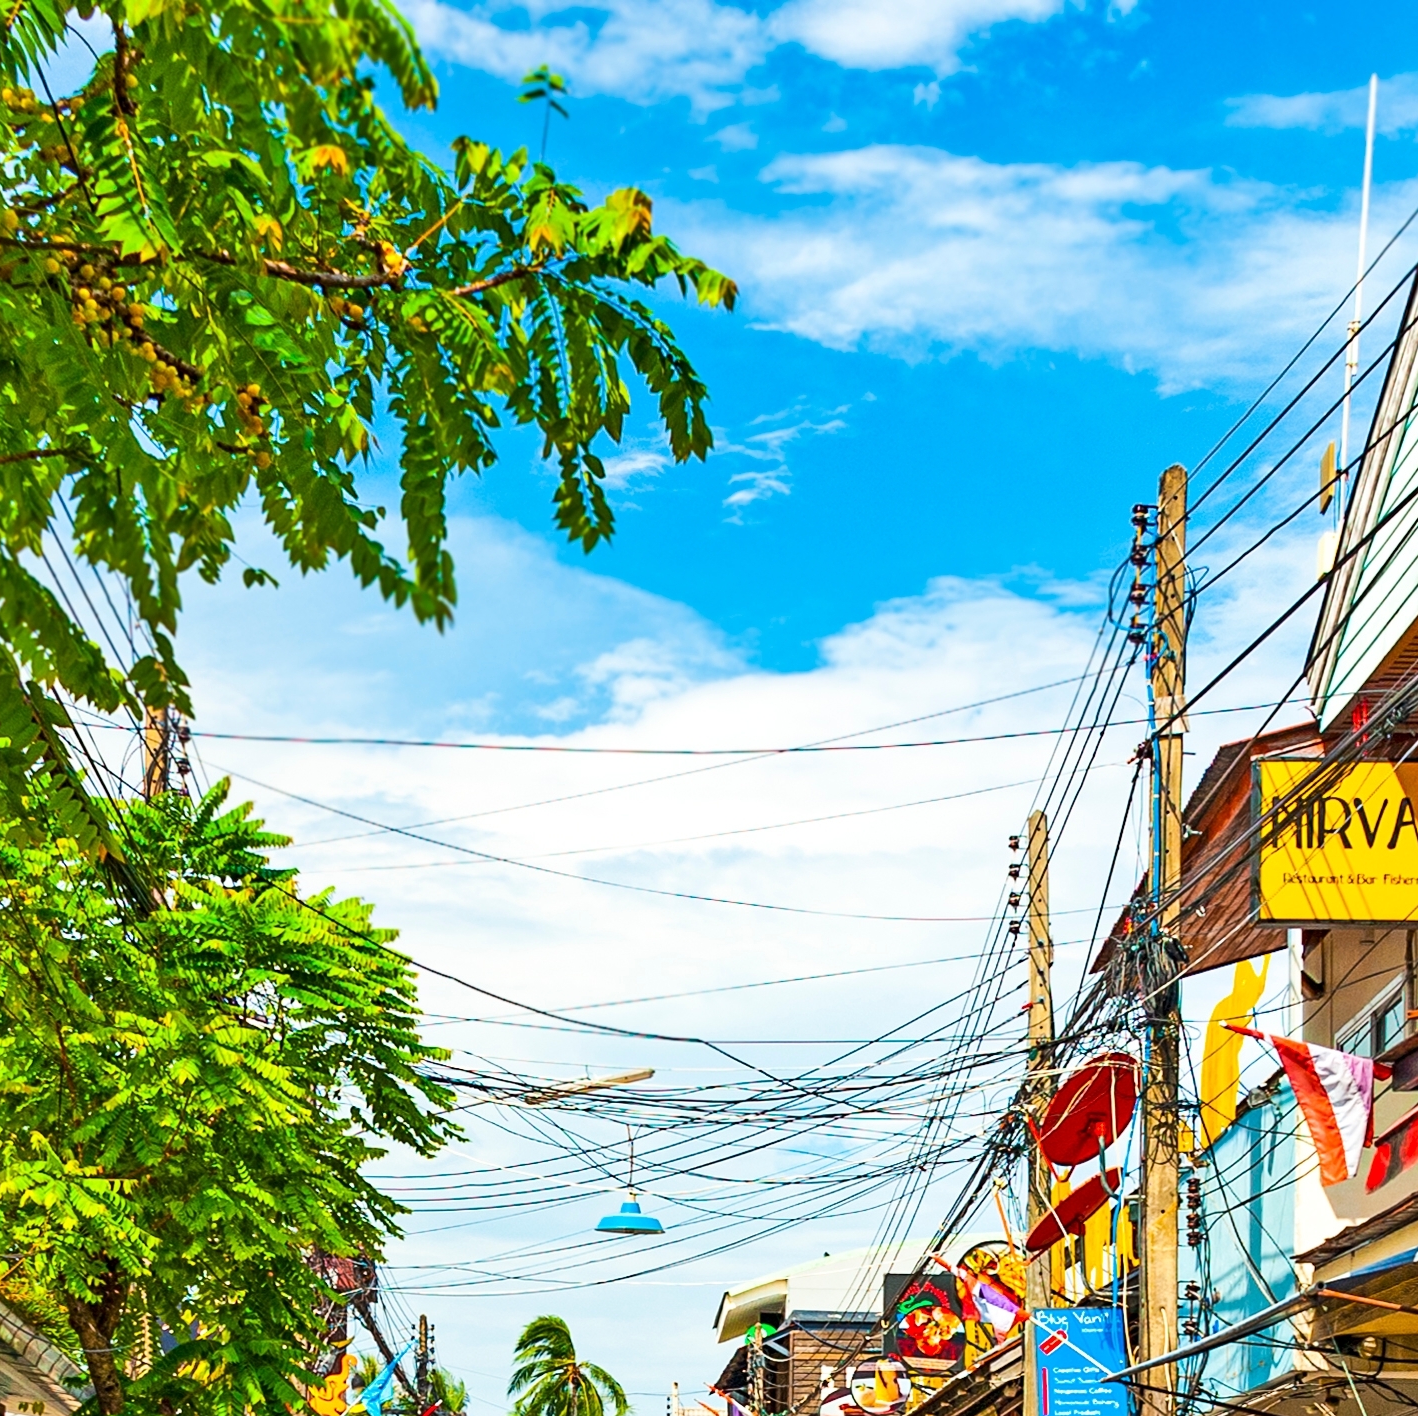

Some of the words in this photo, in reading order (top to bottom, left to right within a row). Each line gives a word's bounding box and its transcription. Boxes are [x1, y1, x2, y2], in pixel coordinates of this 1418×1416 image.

[1282, 872, 1345, 885] Restaurant
[1347, 873, 1355, 885] &
[1357, 874, 1378, 885] Bar
